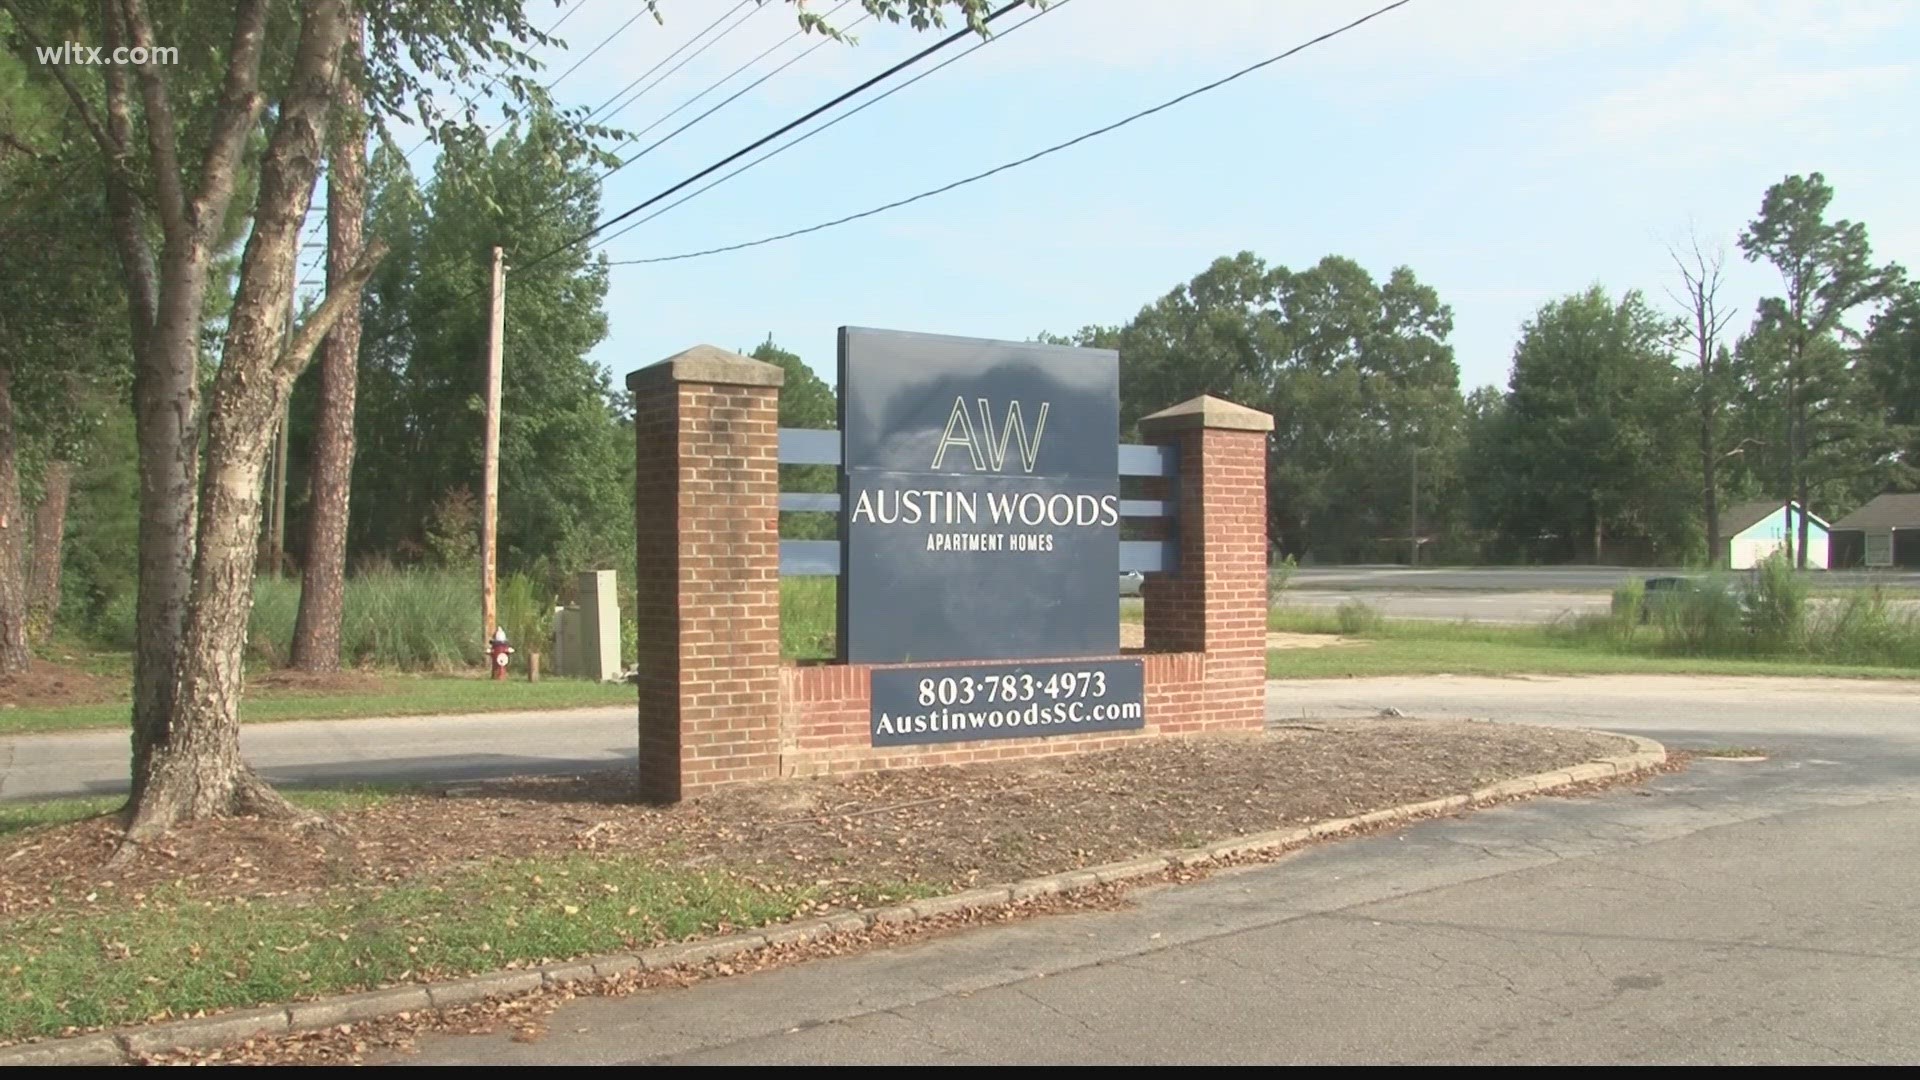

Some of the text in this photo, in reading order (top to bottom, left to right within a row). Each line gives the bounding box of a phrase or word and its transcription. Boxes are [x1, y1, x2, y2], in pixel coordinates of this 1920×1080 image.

[931, 396, 1049, 472] AW
[851, 489, 1119, 526] AUSTIN WOODS
[926, 533, 1053, 551] APARTMENT HOMES
[876, 701, 1141, 735] AustinwoodsSC.com
